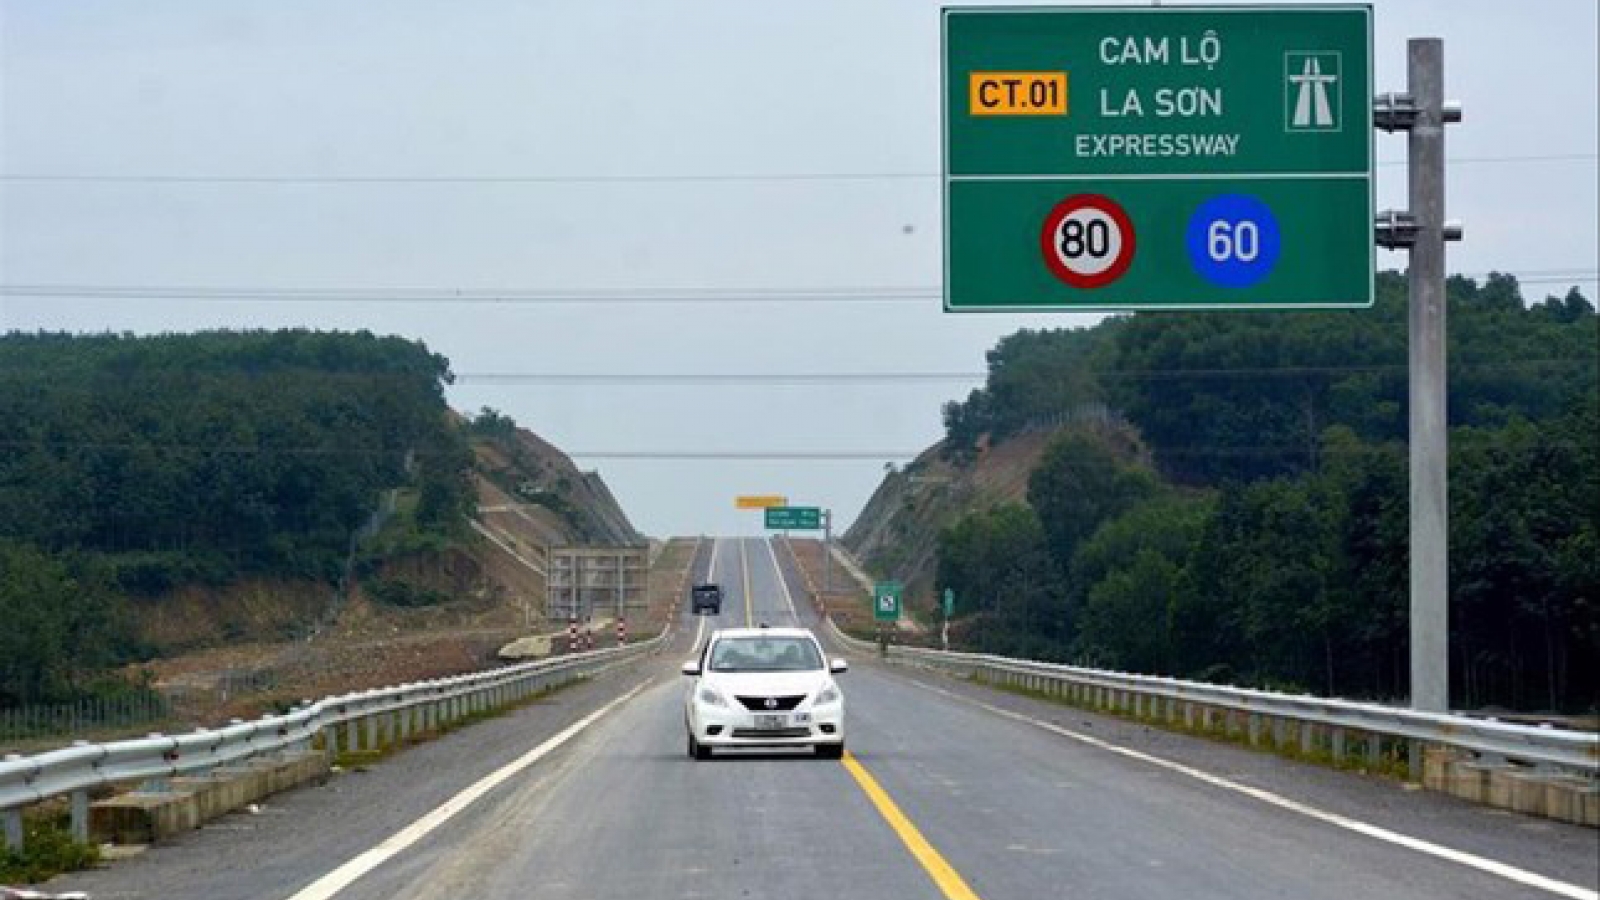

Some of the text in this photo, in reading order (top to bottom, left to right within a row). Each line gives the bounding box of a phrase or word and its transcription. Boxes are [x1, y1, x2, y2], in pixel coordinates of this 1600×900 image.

[1099, 30, 1220, 70] CAM LỘ
[978, 79, 1059, 108] CT.01
[1100, 85, 1222, 117] LA SƠN
[1075, 134, 1239, 157] EXPRESSWAY
[1061, 220, 1110, 259] 80
[1207, 219, 1259, 261] 60
